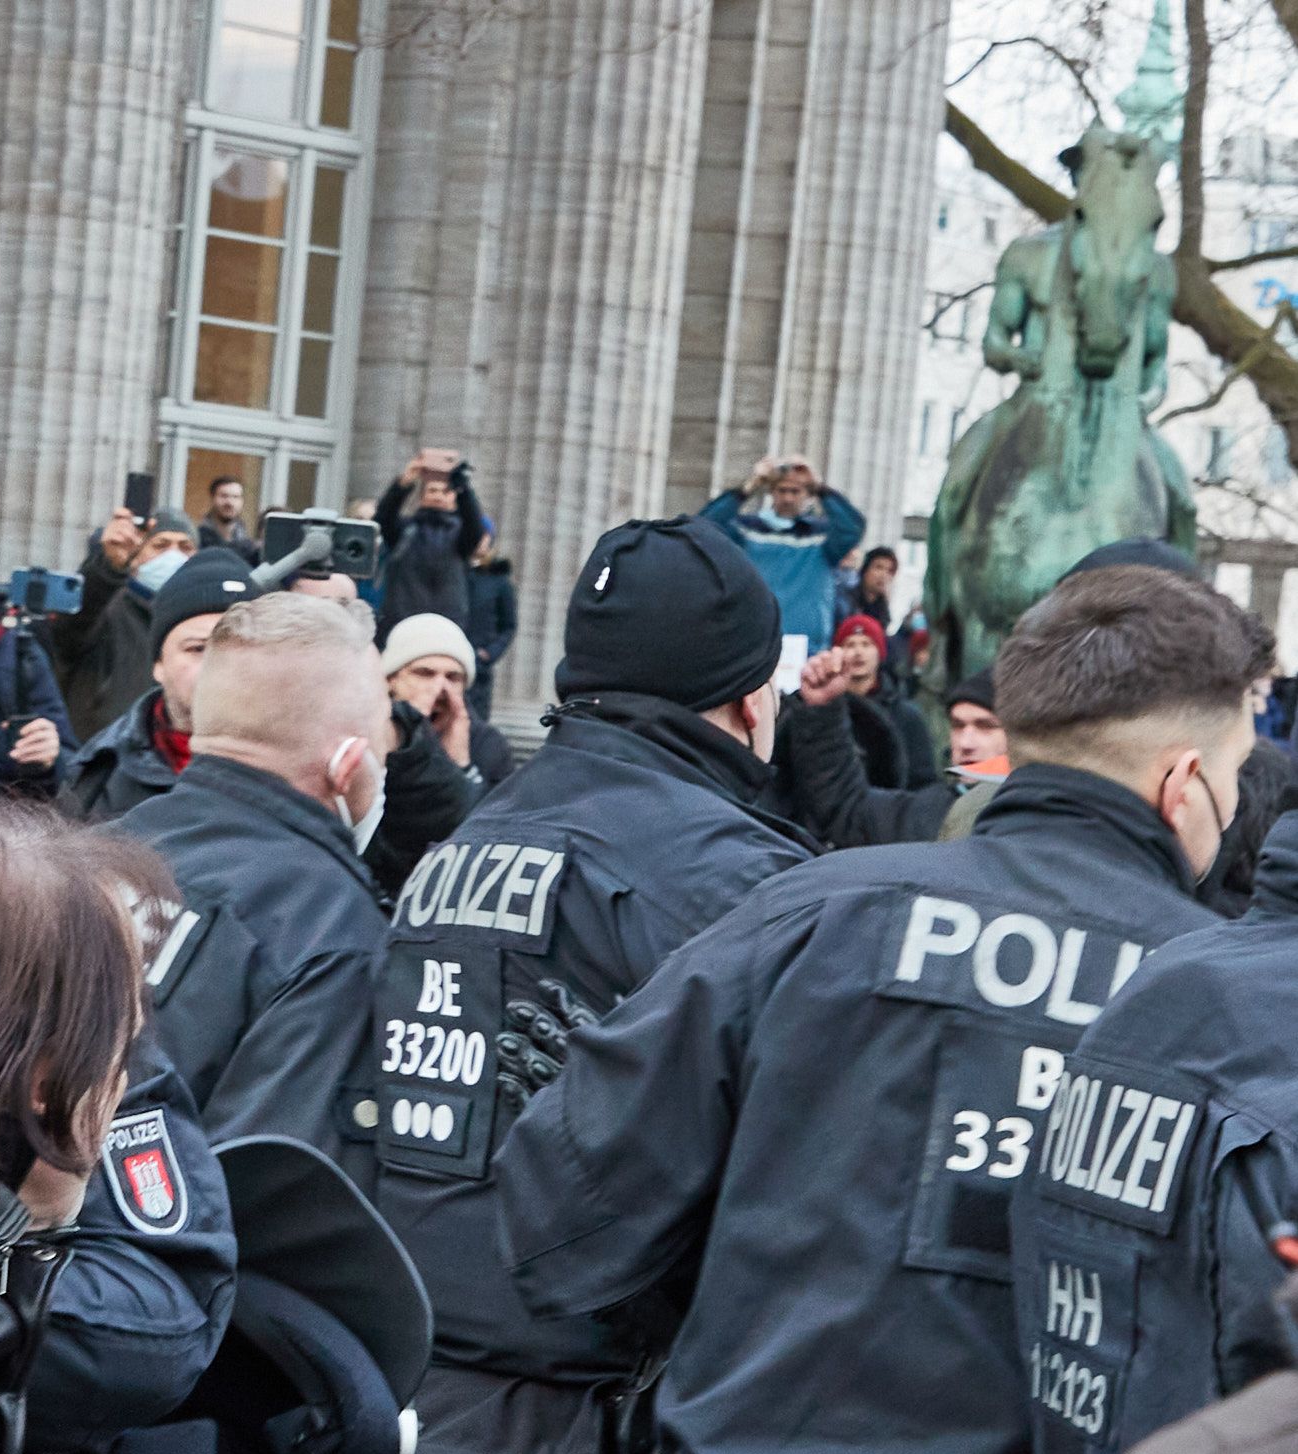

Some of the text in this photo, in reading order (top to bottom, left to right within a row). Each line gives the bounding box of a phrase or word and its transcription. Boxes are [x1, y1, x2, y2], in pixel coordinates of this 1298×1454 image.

[390, 843, 565, 936] POLIZEI
[416, 959, 462, 1017] BE
[381, 1019, 486, 1086] 33200
[1040, 1070, 1196, 1213] POLIZEI
[1046, 1260, 1103, 1347] HH
